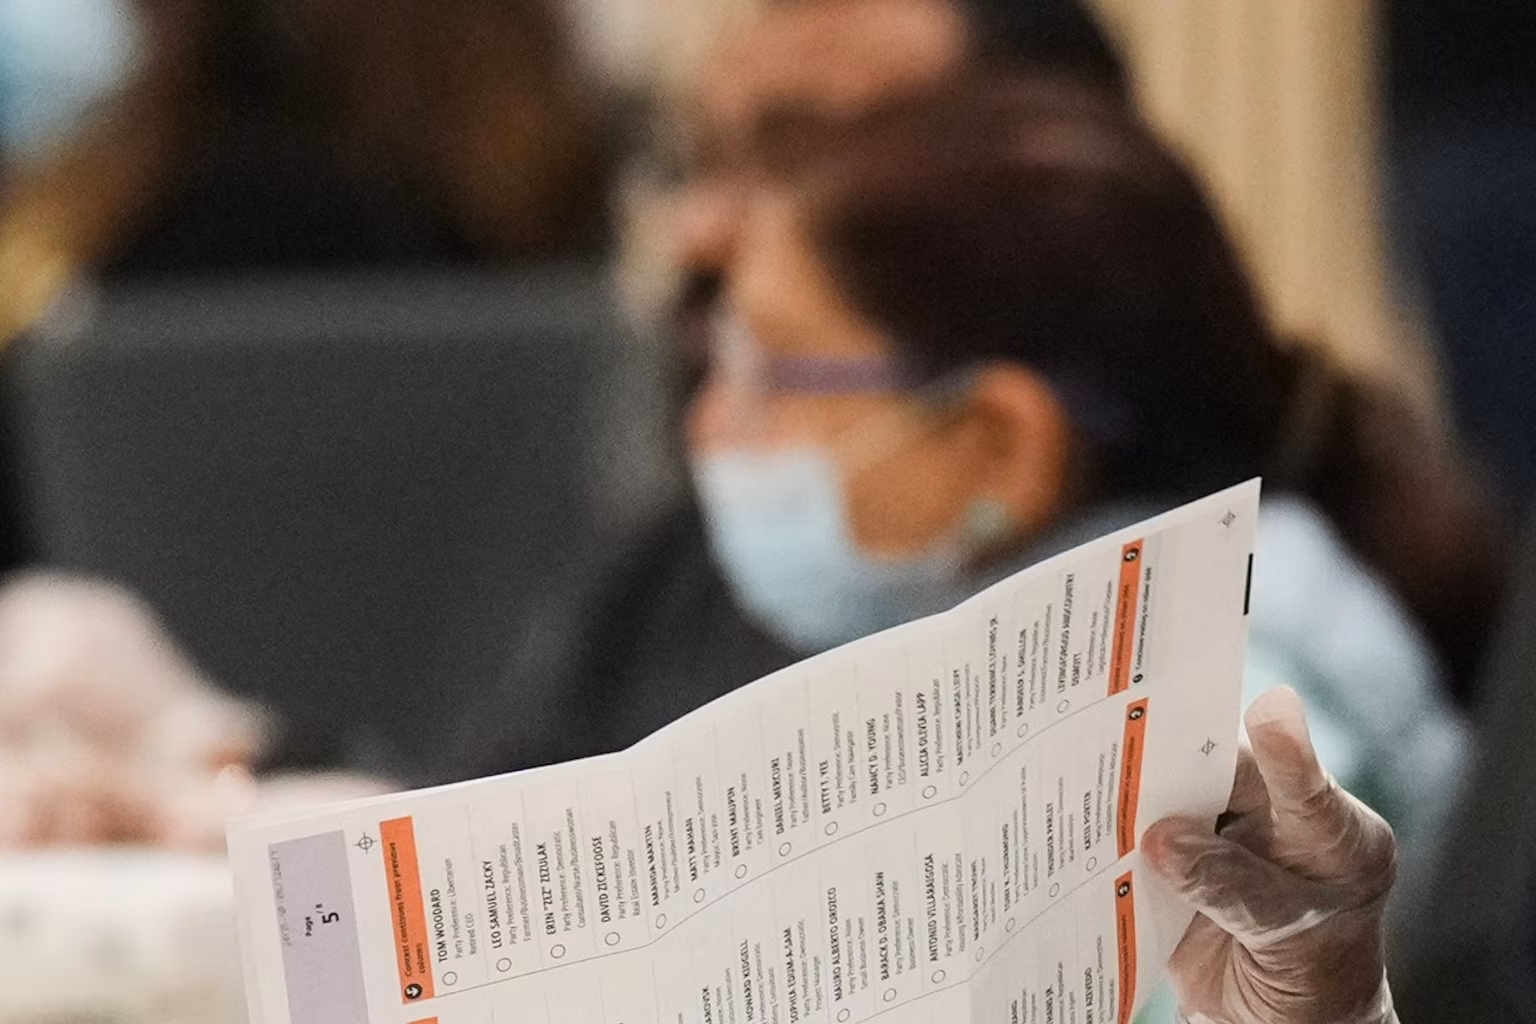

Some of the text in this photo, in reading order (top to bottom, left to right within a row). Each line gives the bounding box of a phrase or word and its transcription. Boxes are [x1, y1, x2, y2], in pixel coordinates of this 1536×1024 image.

[770, 757, 785, 835] DANIEL MERCURI
[536, 842, 556, 935] ERIN "ZEZ" ZEZULAK
[591, 835, 611, 923] DAVID ZICKEFOOSE
[685, 817, 698, 882] MATT MAHAN
[303, 916, 314, 938] Page
[322, 911, 340, 924] 5
[388, 841, 413, 978] Contest continues from previous
[429, 888, 448, 963] TOM WOODARD
[482, 861, 502, 949] LEO SAMUEL ZACKY
[875, 871, 890, 981] BARACK D. OBAMA SHAW
[924, 853, 938, 962] ANTONIO VILLARAIGOSA
[416, 942, 426, 974] column
[740, 939, 750, 979] KIDGELL
[827, 887, 842, 1002] MAURO ALBERTO OROZCO
[743, 978, 754, 1022] HOWARD
